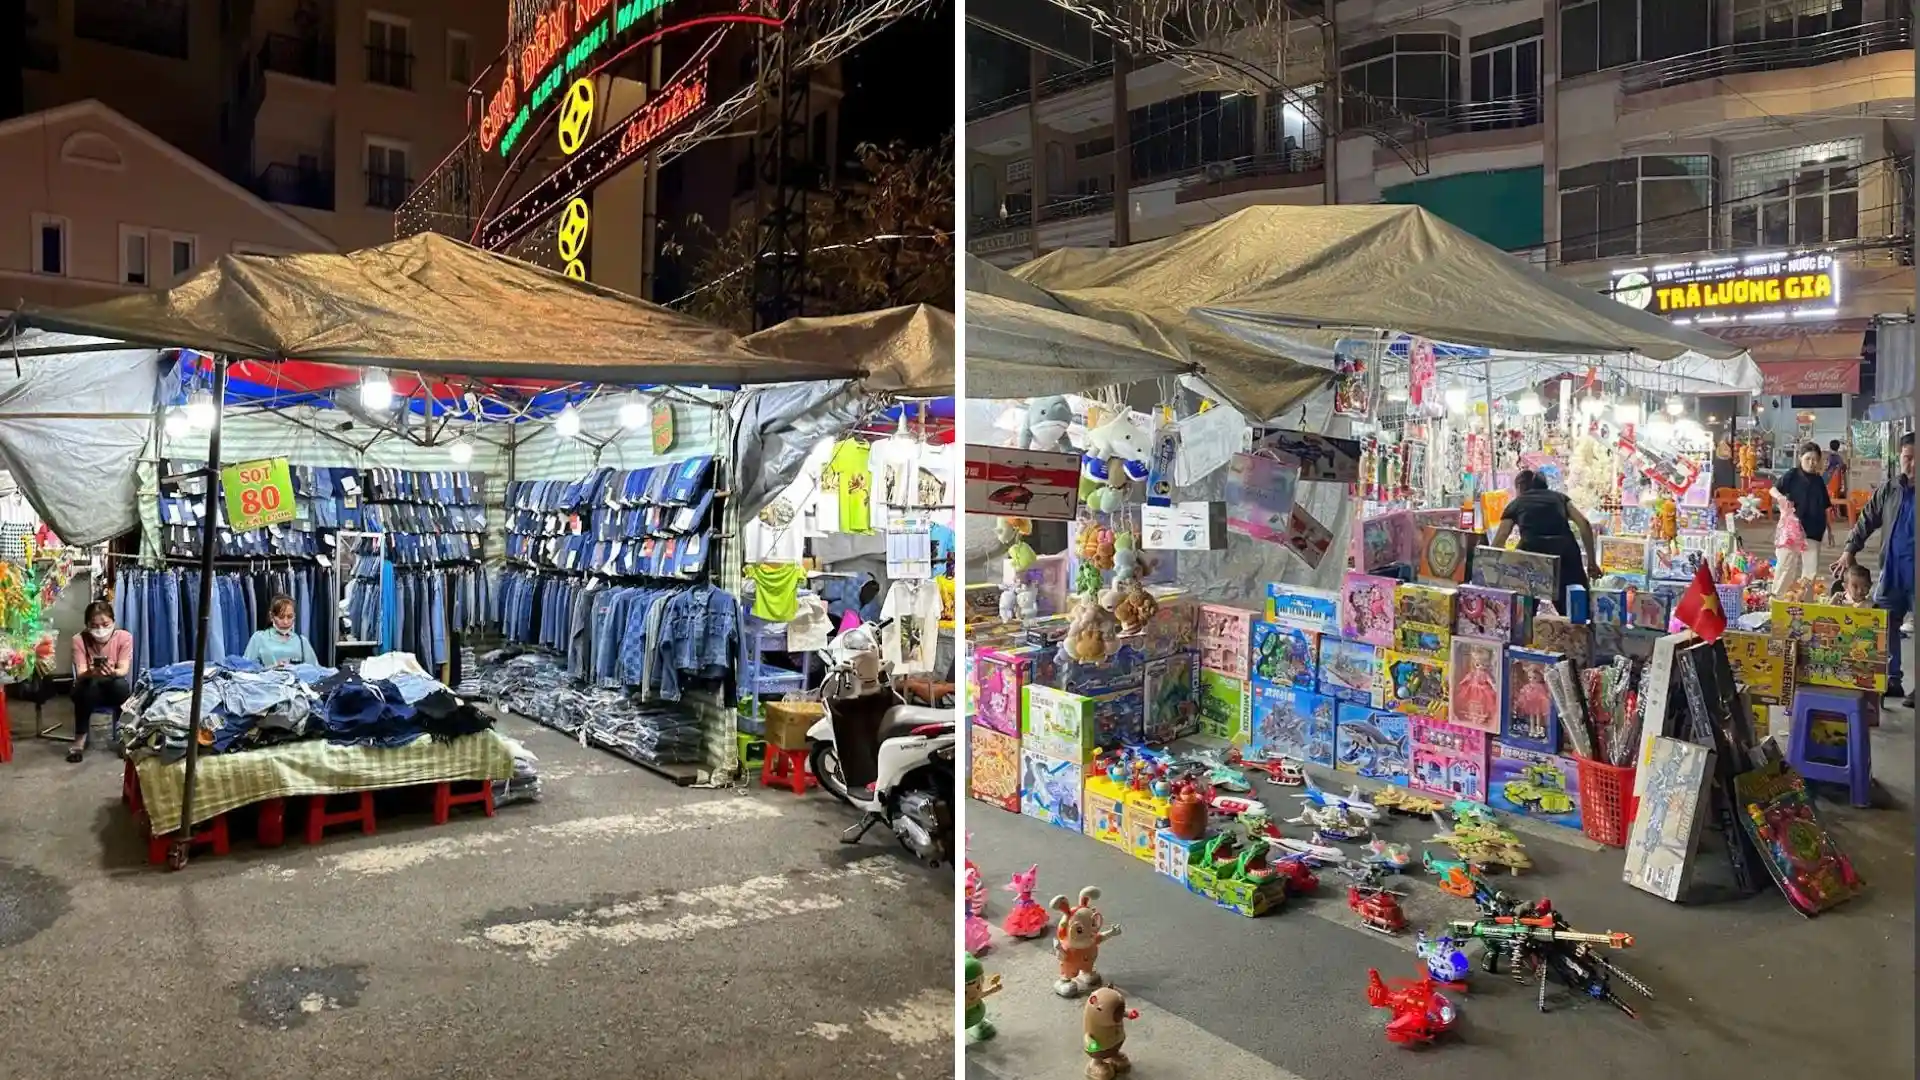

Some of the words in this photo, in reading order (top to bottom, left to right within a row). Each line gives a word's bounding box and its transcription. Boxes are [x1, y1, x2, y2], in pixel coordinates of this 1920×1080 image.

[566, 18, 608, 74] NIGHT
[480, 64, 516, 152] CHỢ
[522, 1, 568, 92] ĐÊM
[1784, 274, 1832, 299] GIA
[241, 485, 280, 515] 80
